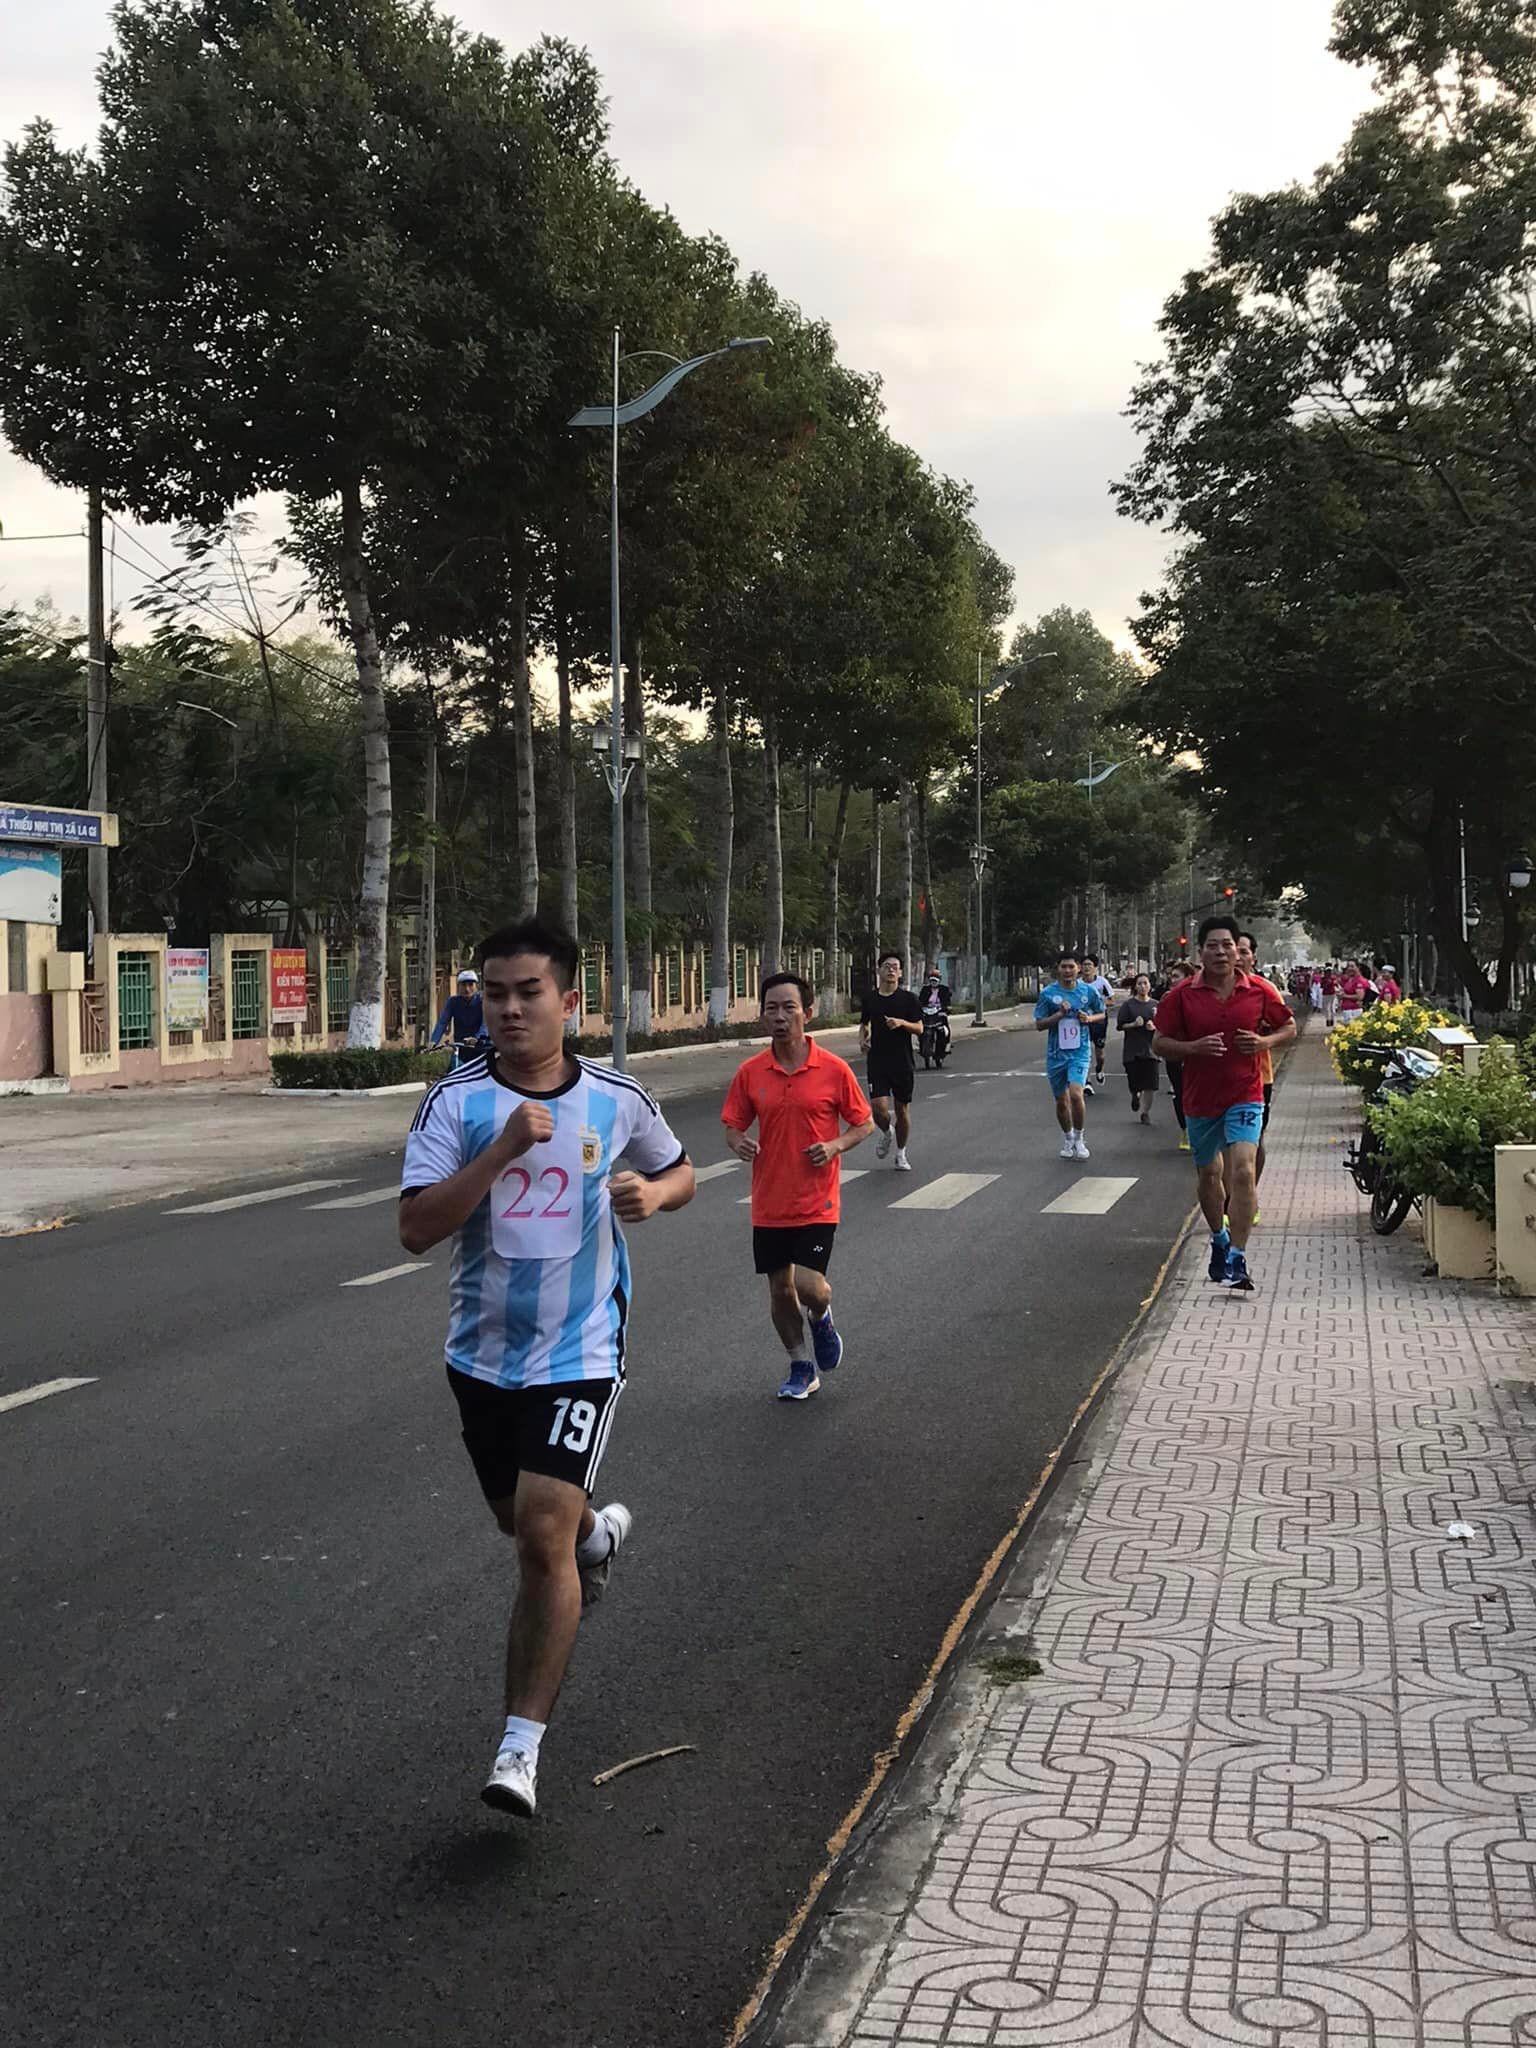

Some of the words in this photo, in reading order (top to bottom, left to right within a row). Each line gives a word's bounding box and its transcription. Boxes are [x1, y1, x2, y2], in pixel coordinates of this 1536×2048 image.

[34, 820, 49, 833] NHI
[78, 825, 87, 837] LA
[1063, 1026, 1078, 1041] 19
[1240, 1110, 1257, 1127] 12
[500, 1166, 571, 1219] 22
[547, 1397, 597, 1453] 19
